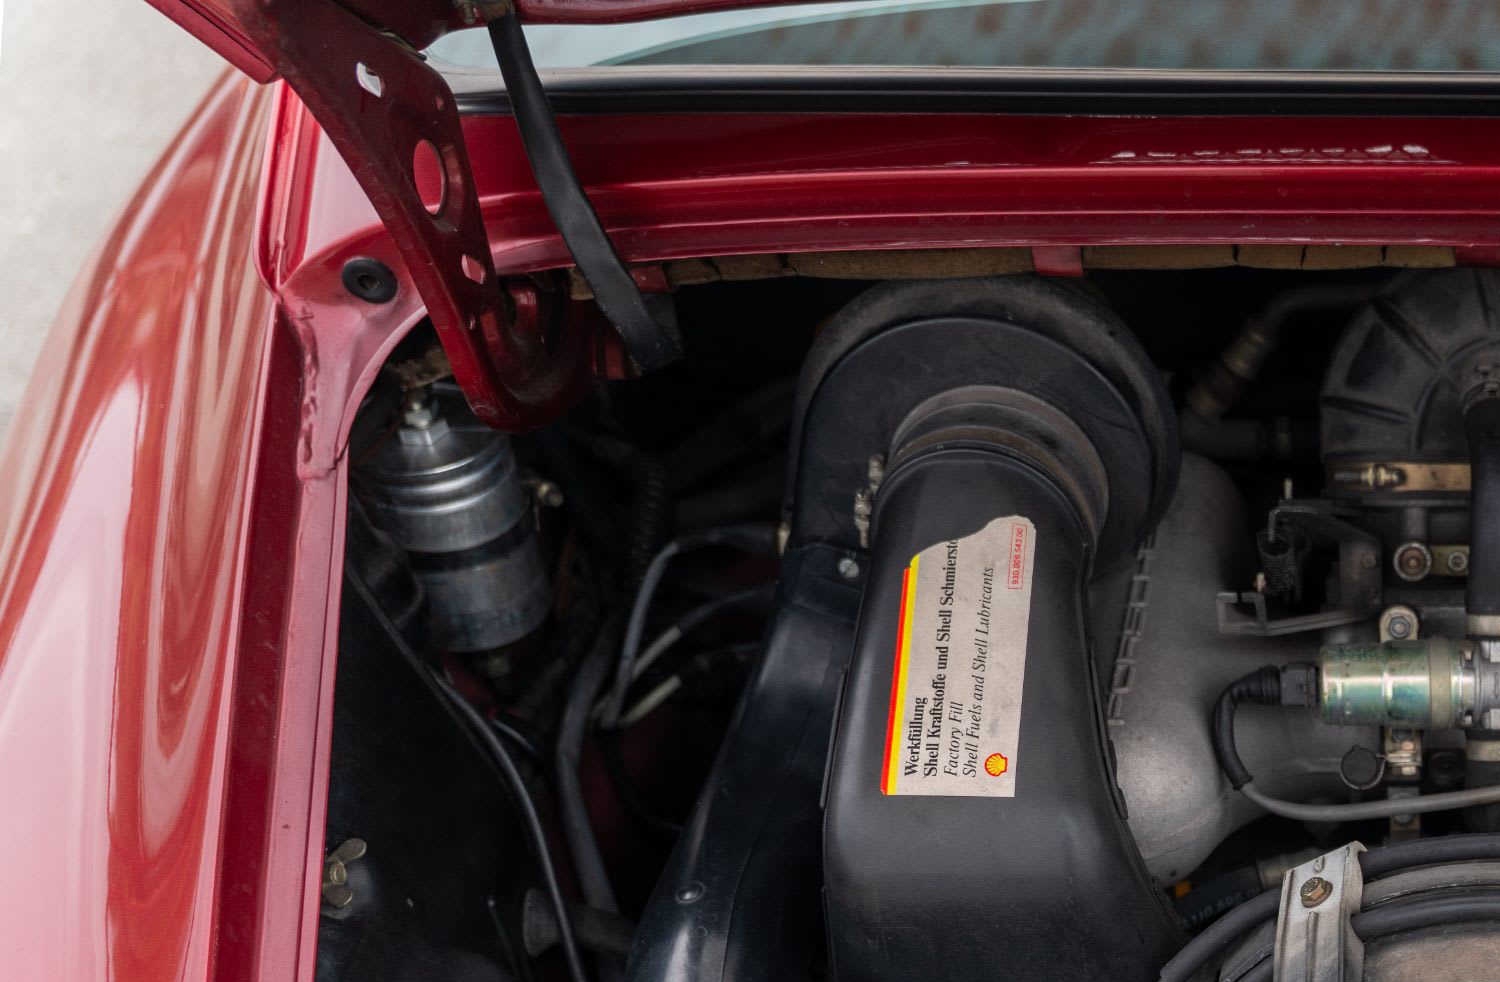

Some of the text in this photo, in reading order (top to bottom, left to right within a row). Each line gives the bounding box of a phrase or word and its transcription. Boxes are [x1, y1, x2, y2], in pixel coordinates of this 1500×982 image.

[936, 610, 952, 642] Shell
[936, 646, 948, 670] und
[963, 567, 994, 778] Shell Fuels and Shell Lubricants
[904, 697, 928, 776] Werkfüllung
[927, 673, 947, 739] Kraftstoffe
[944, 701, 964, 776] Factory Fill
[923, 743, 939, 777] Shell
